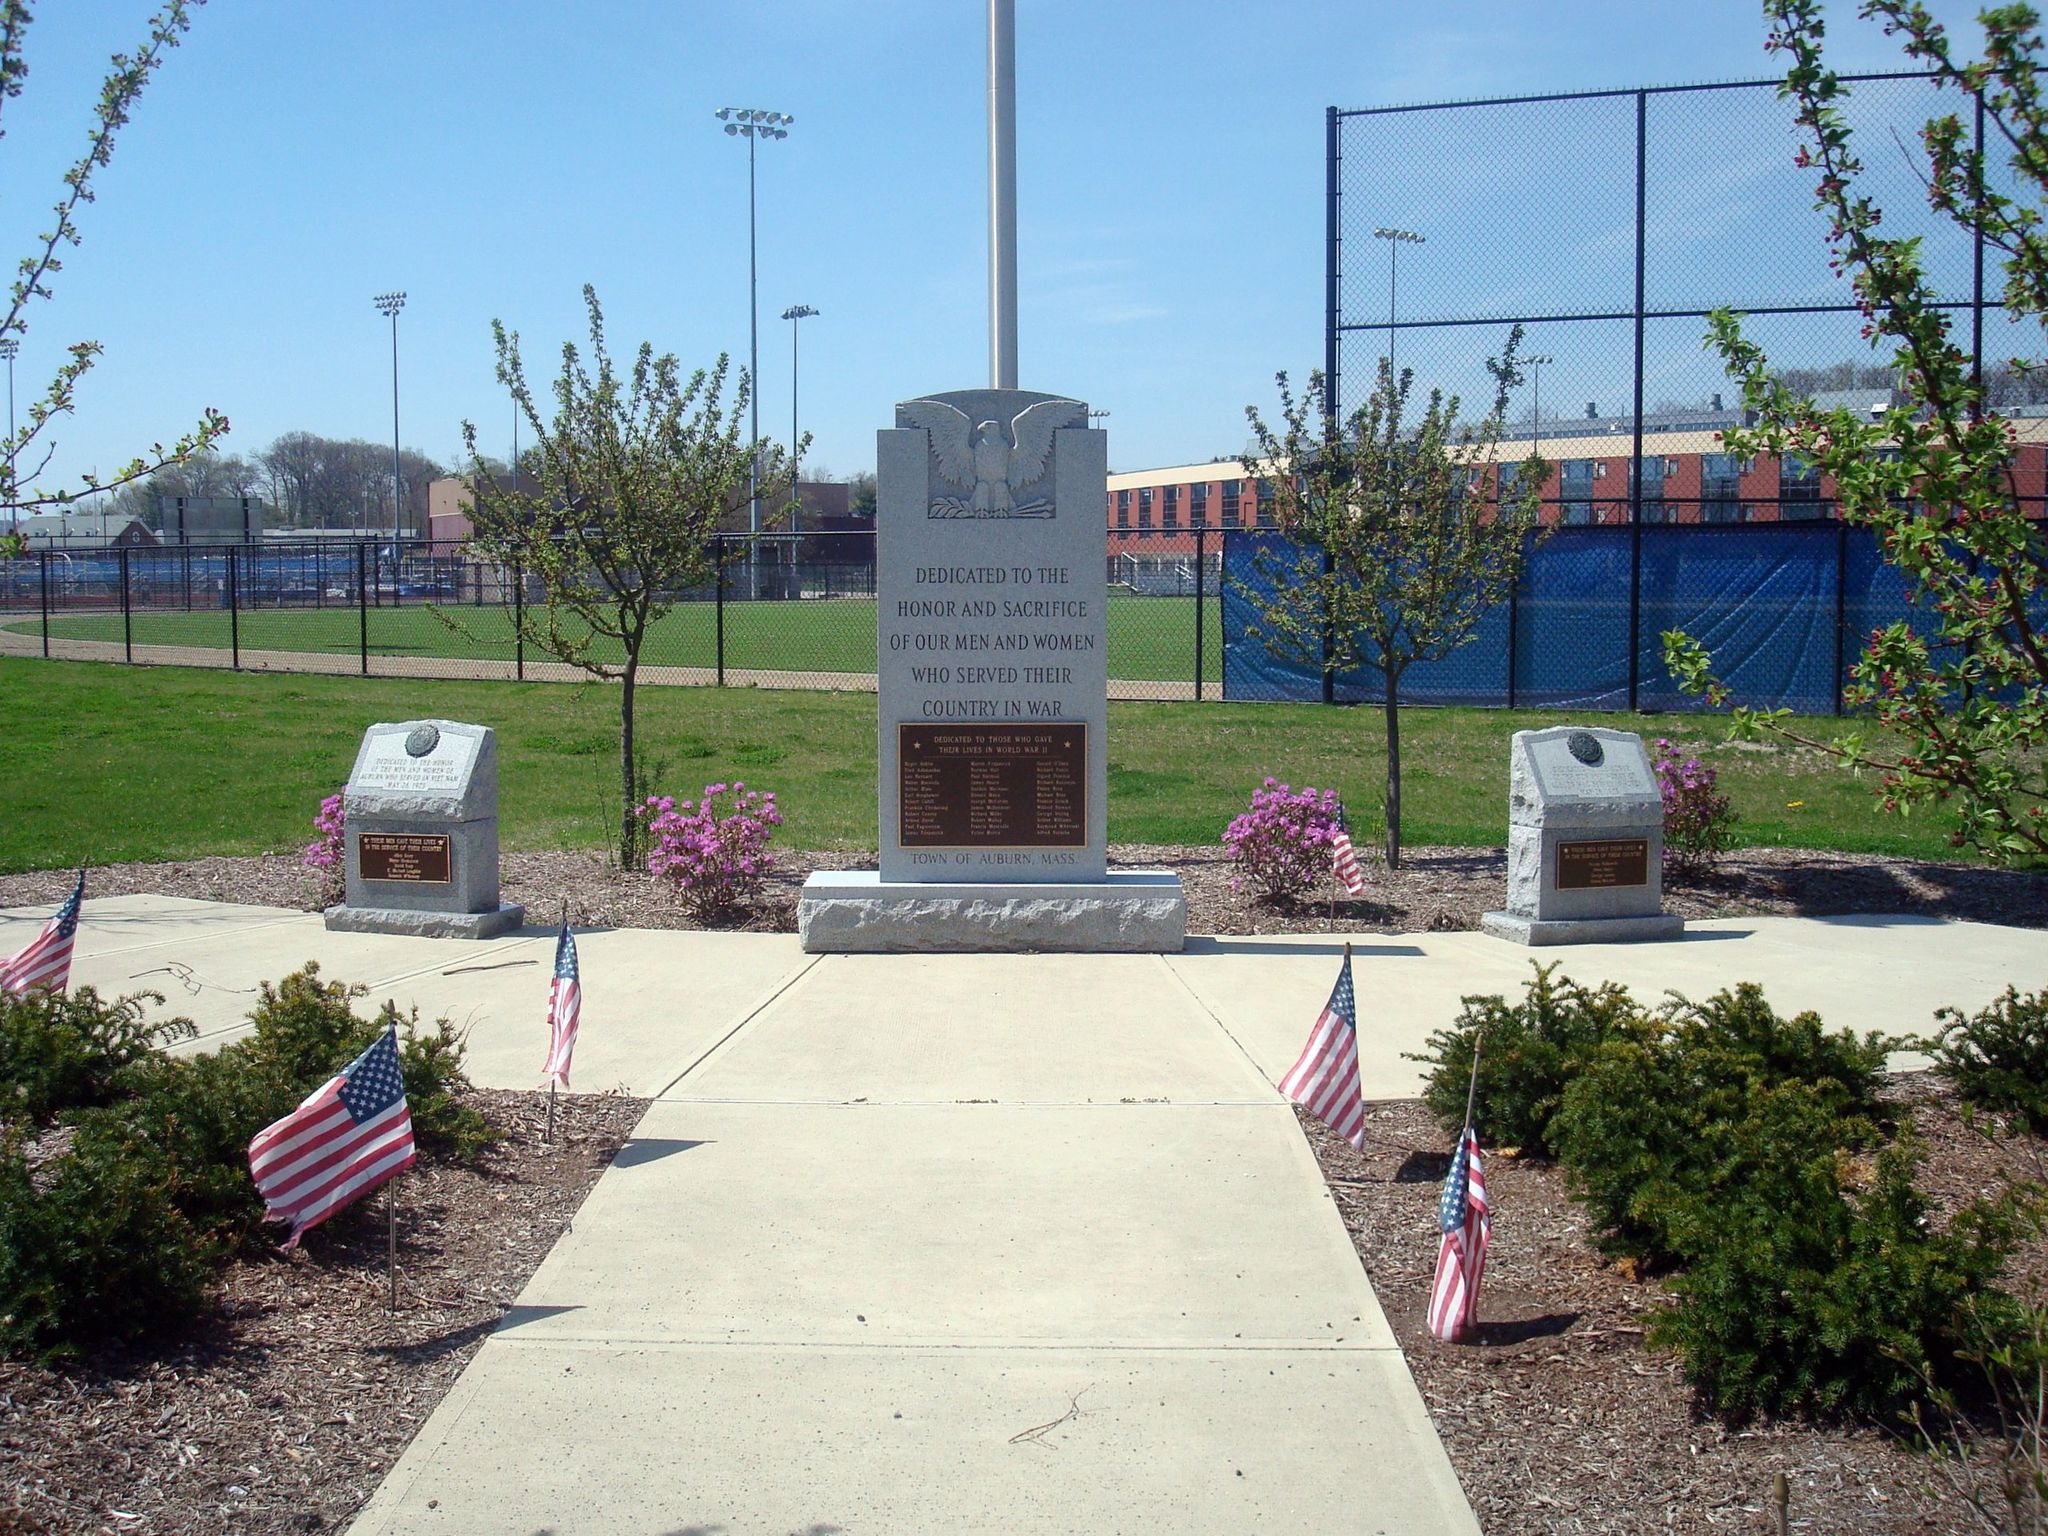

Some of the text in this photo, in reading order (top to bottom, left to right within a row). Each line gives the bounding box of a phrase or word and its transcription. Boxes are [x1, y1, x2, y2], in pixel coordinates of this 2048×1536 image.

[916, 567, 1069, 584] DEDICATED TO THE
[898, 601, 1087, 617] HONOR AND SACRIFICE
[890, 634, 1095, 651] OF OUR MEN AND WOMEN
[912, 667, 1073, 684] WHO SERVED THEIR
[923, 700, 1062, 717] COUNTRY IN WAR
[939, 746, 1048, 754] THEIR LIVES IN WORLD WAR II
[911, 854, 1078, 865] TOWN OF AUBURN, MASS.
